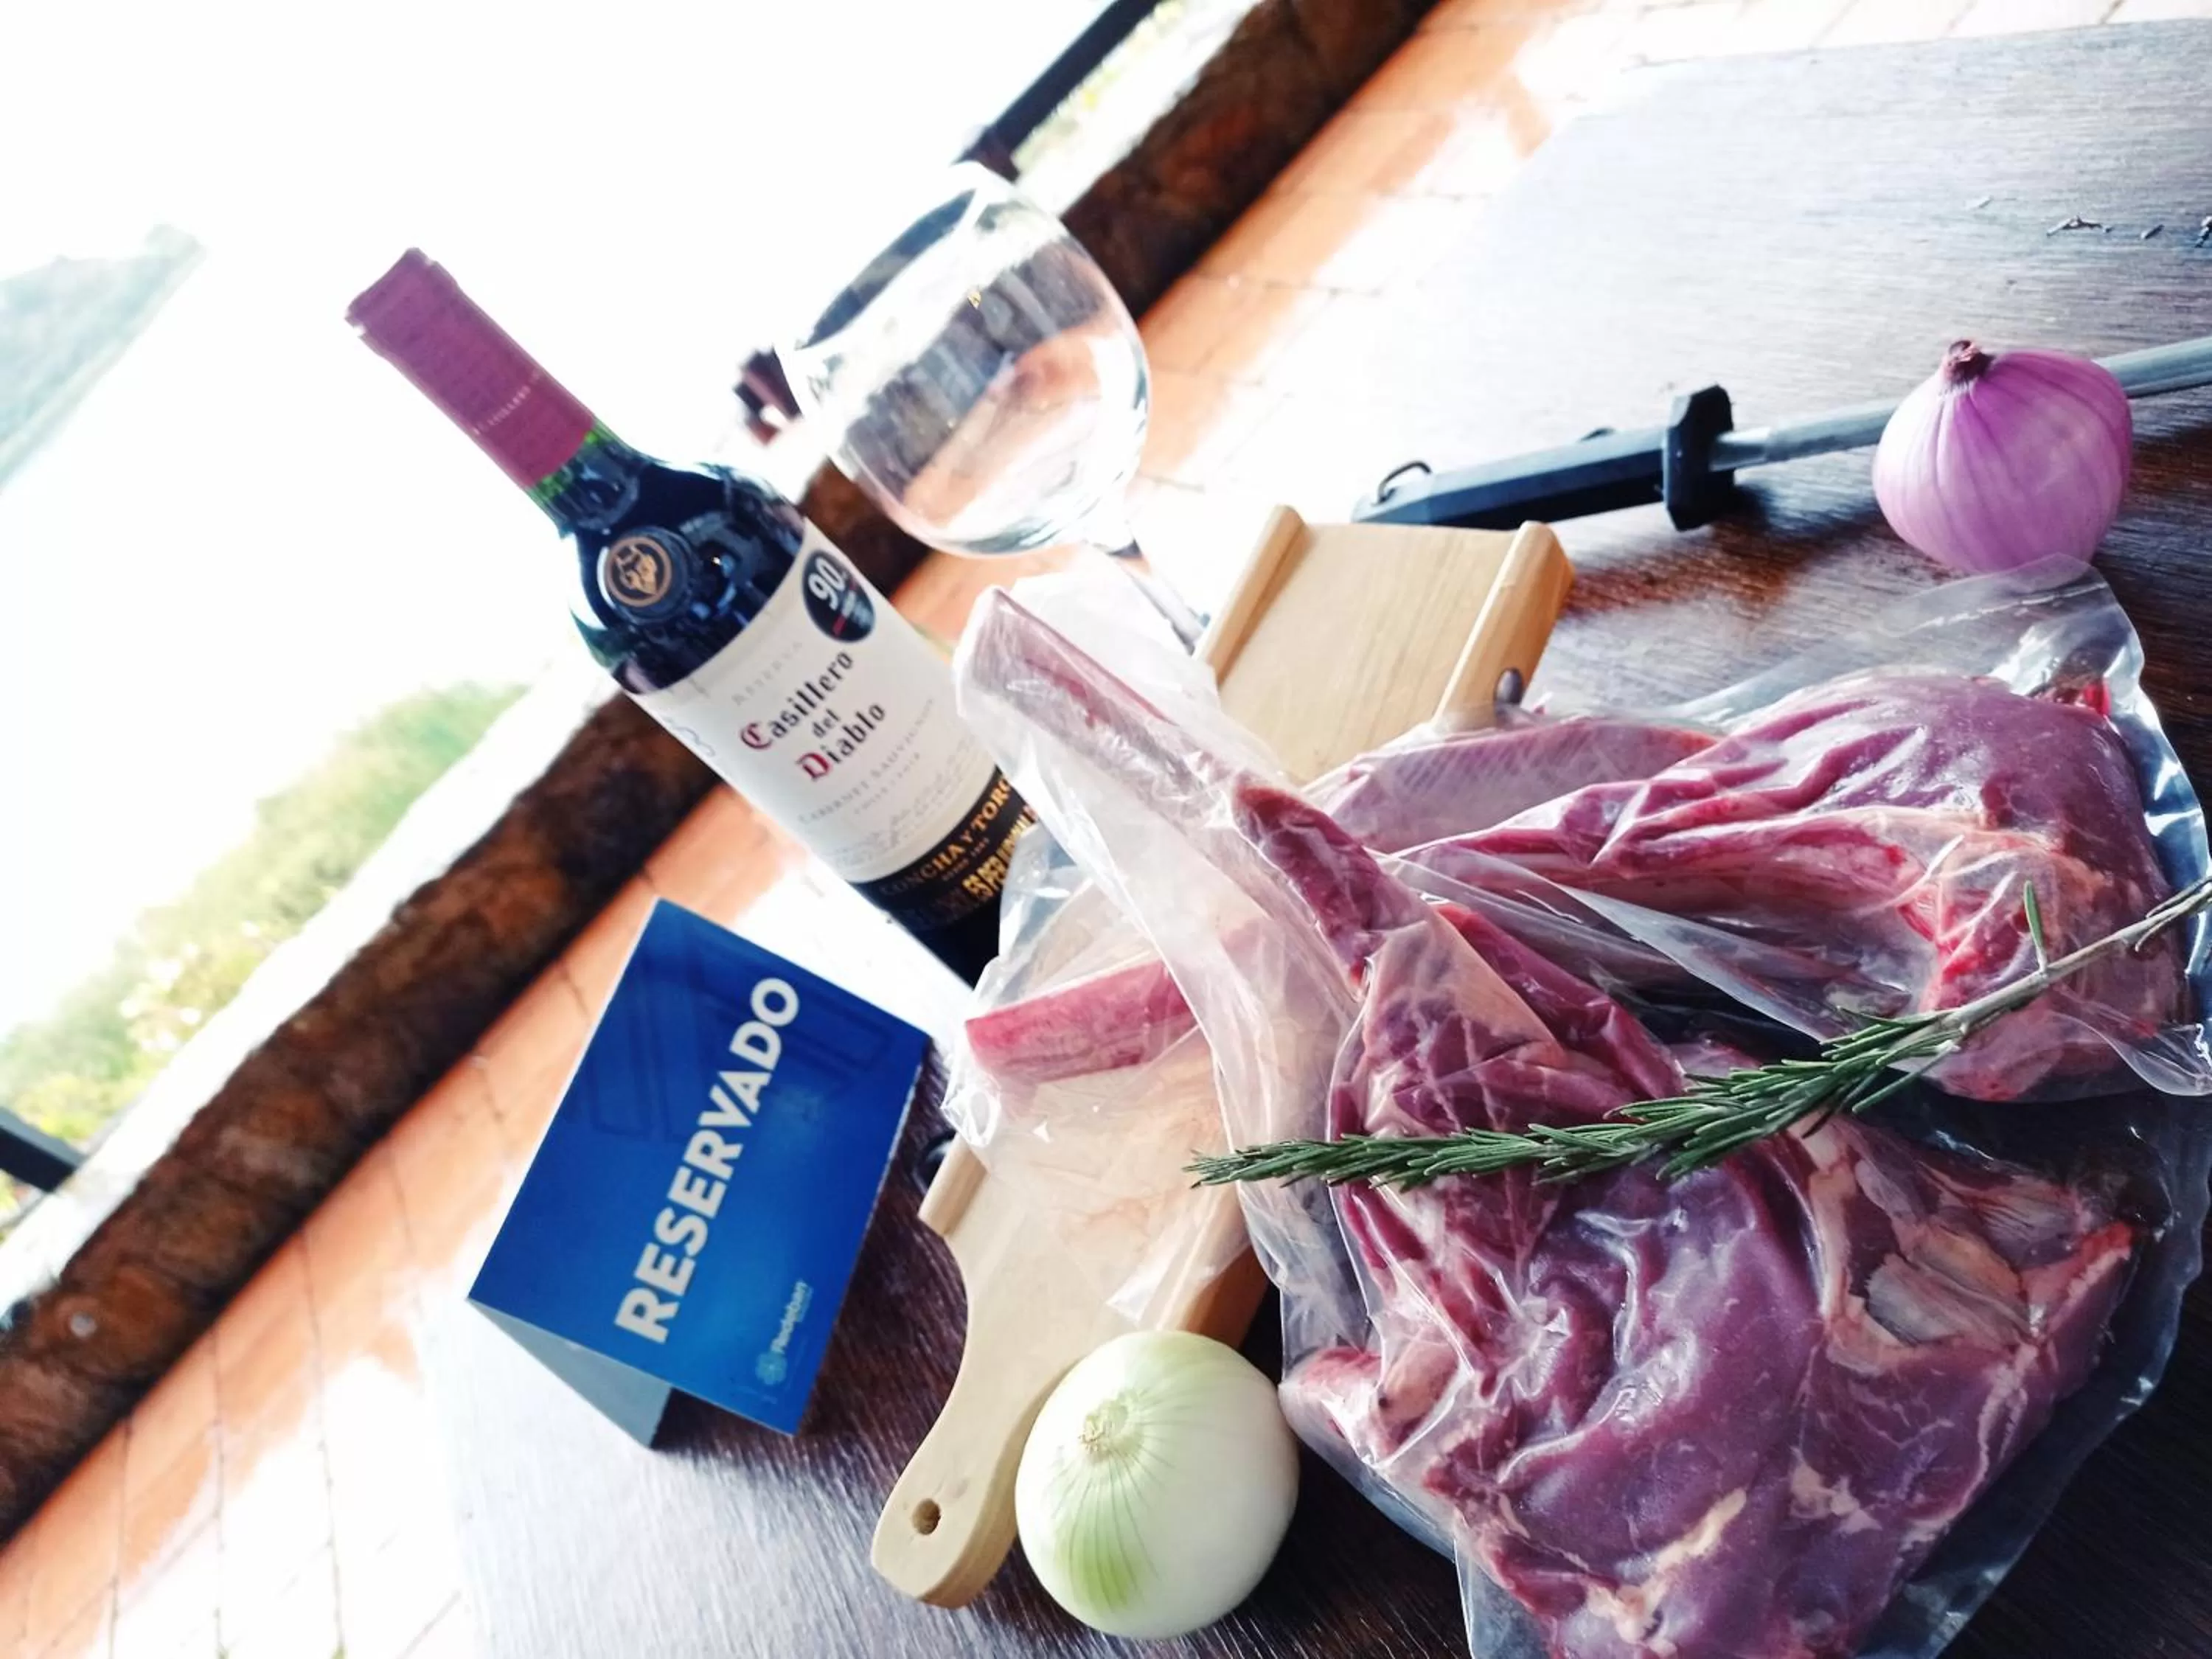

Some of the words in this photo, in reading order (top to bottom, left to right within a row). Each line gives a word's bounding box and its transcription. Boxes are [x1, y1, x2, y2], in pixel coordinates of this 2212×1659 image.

[740, 651, 855, 751] Casillero
[795, 703, 886, 782] Diablo
[811, 708, 841, 739] del
[613, 978, 800, 1344] RESERVADO
